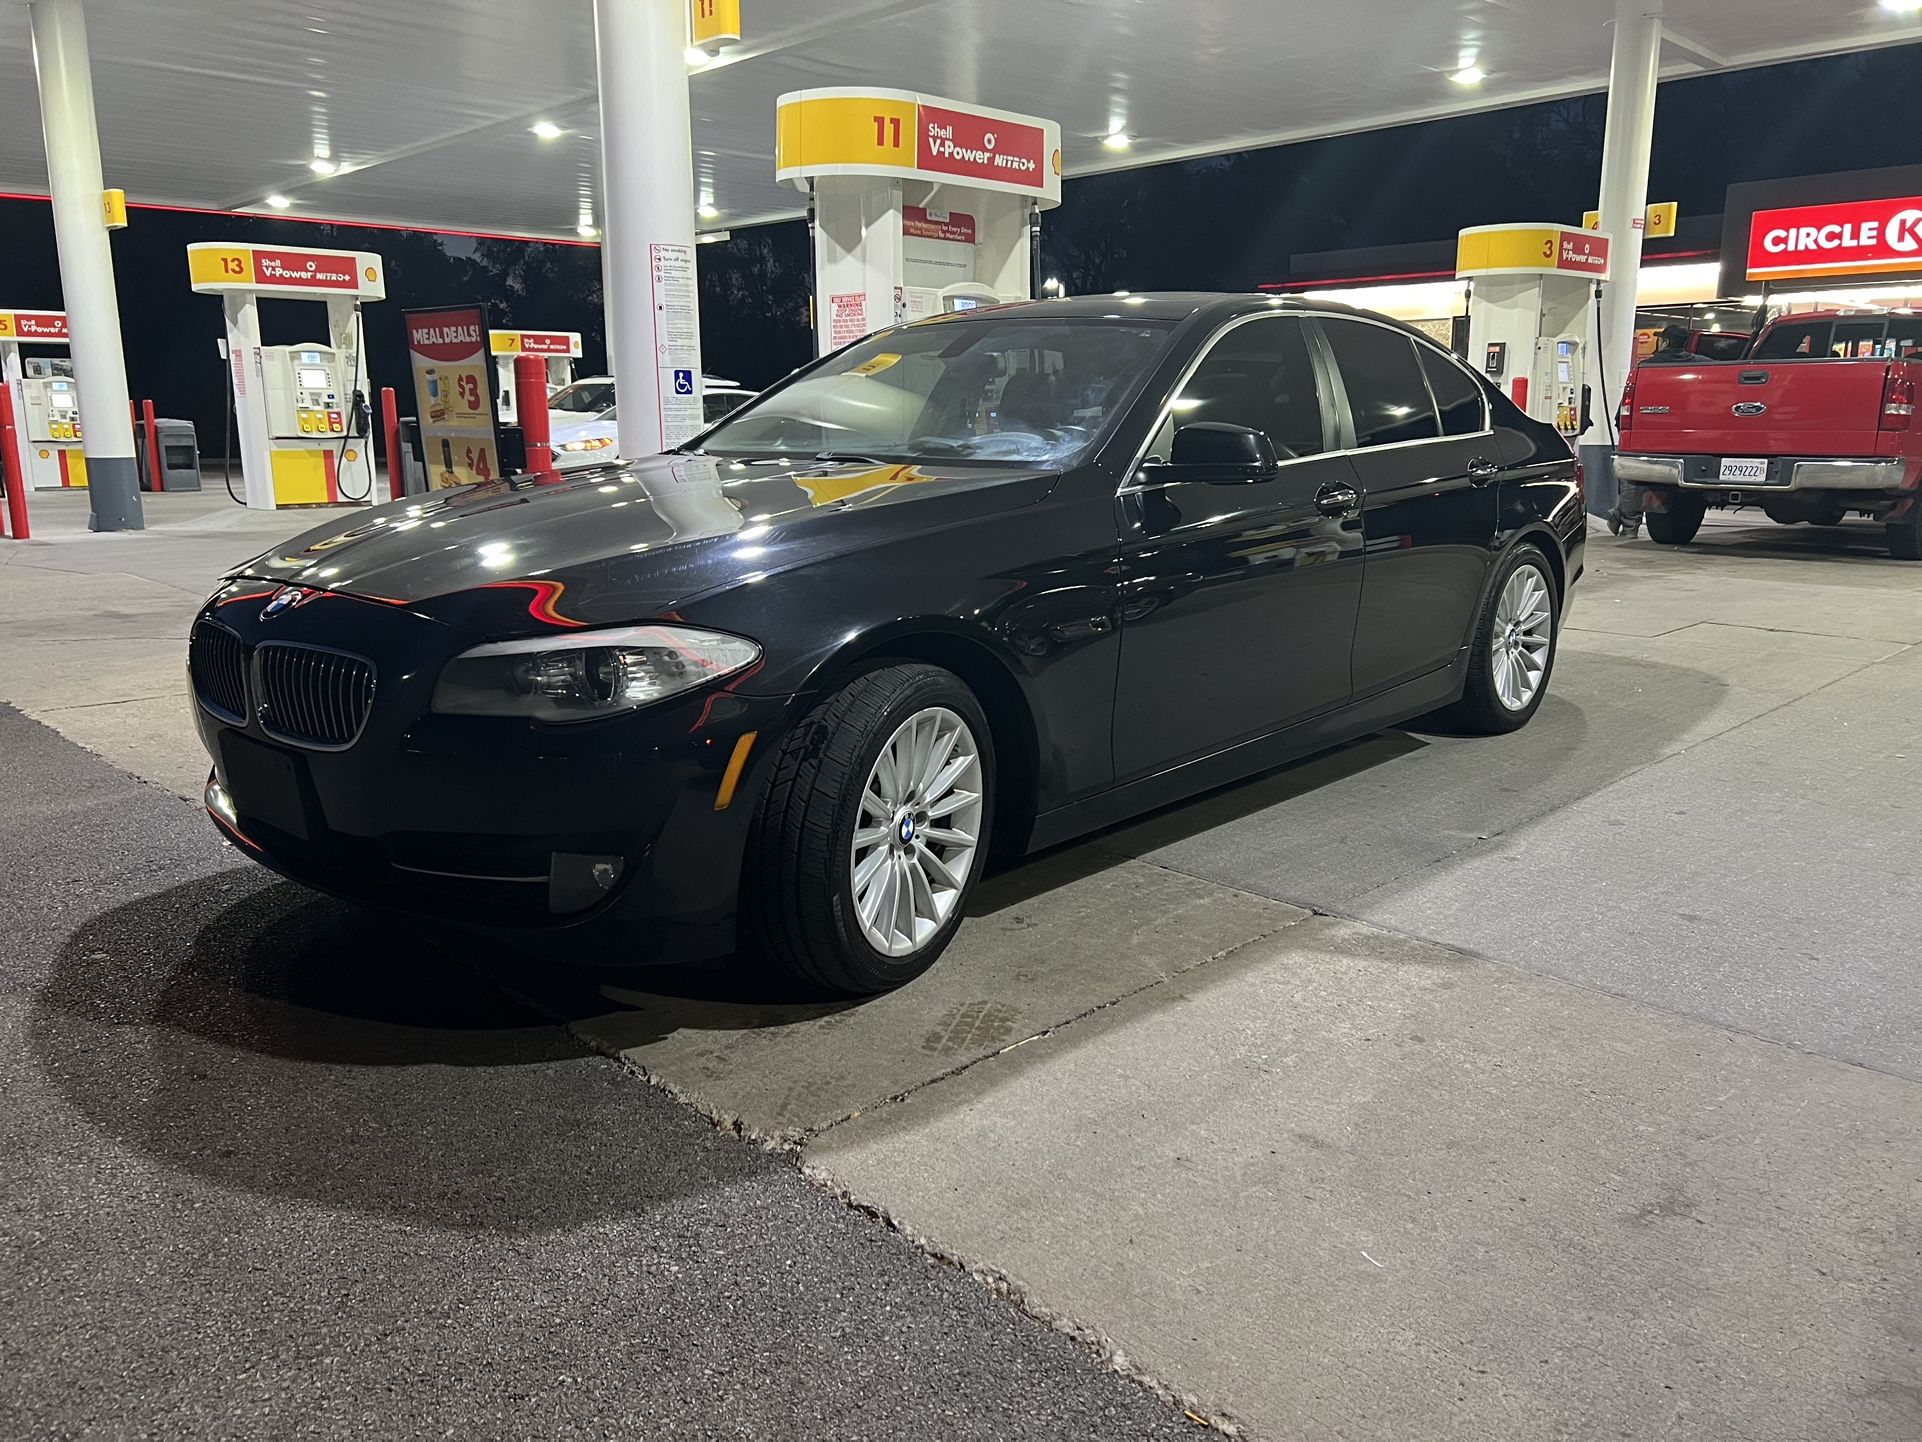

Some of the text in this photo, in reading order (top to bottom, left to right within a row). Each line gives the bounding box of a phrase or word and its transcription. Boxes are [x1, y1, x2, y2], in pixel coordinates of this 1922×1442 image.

[873, 115, 901, 149] 11
[928, 123, 953, 139] Shell
[928, 137, 991, 164] V-Power
[1653, 214, 1662, 226] 3
[1763, 221, 1879, 253] CIRCLE
[1543, 240, 1553, 258] 3
[1562, 250, 1587, 262] V-Power
[221, 257, 244, 275] 13
[261, 258, 281, 267] Shell
[262, 267, 312, 280] V-Power
[22, 325, 59, 333] V-Power
[412, 325, 480, 345] MEAL DEALS!
[508, 338, 515, 347] 7
[457, 374, 481, 411] $3
[465, 446, 491, 481] $4
